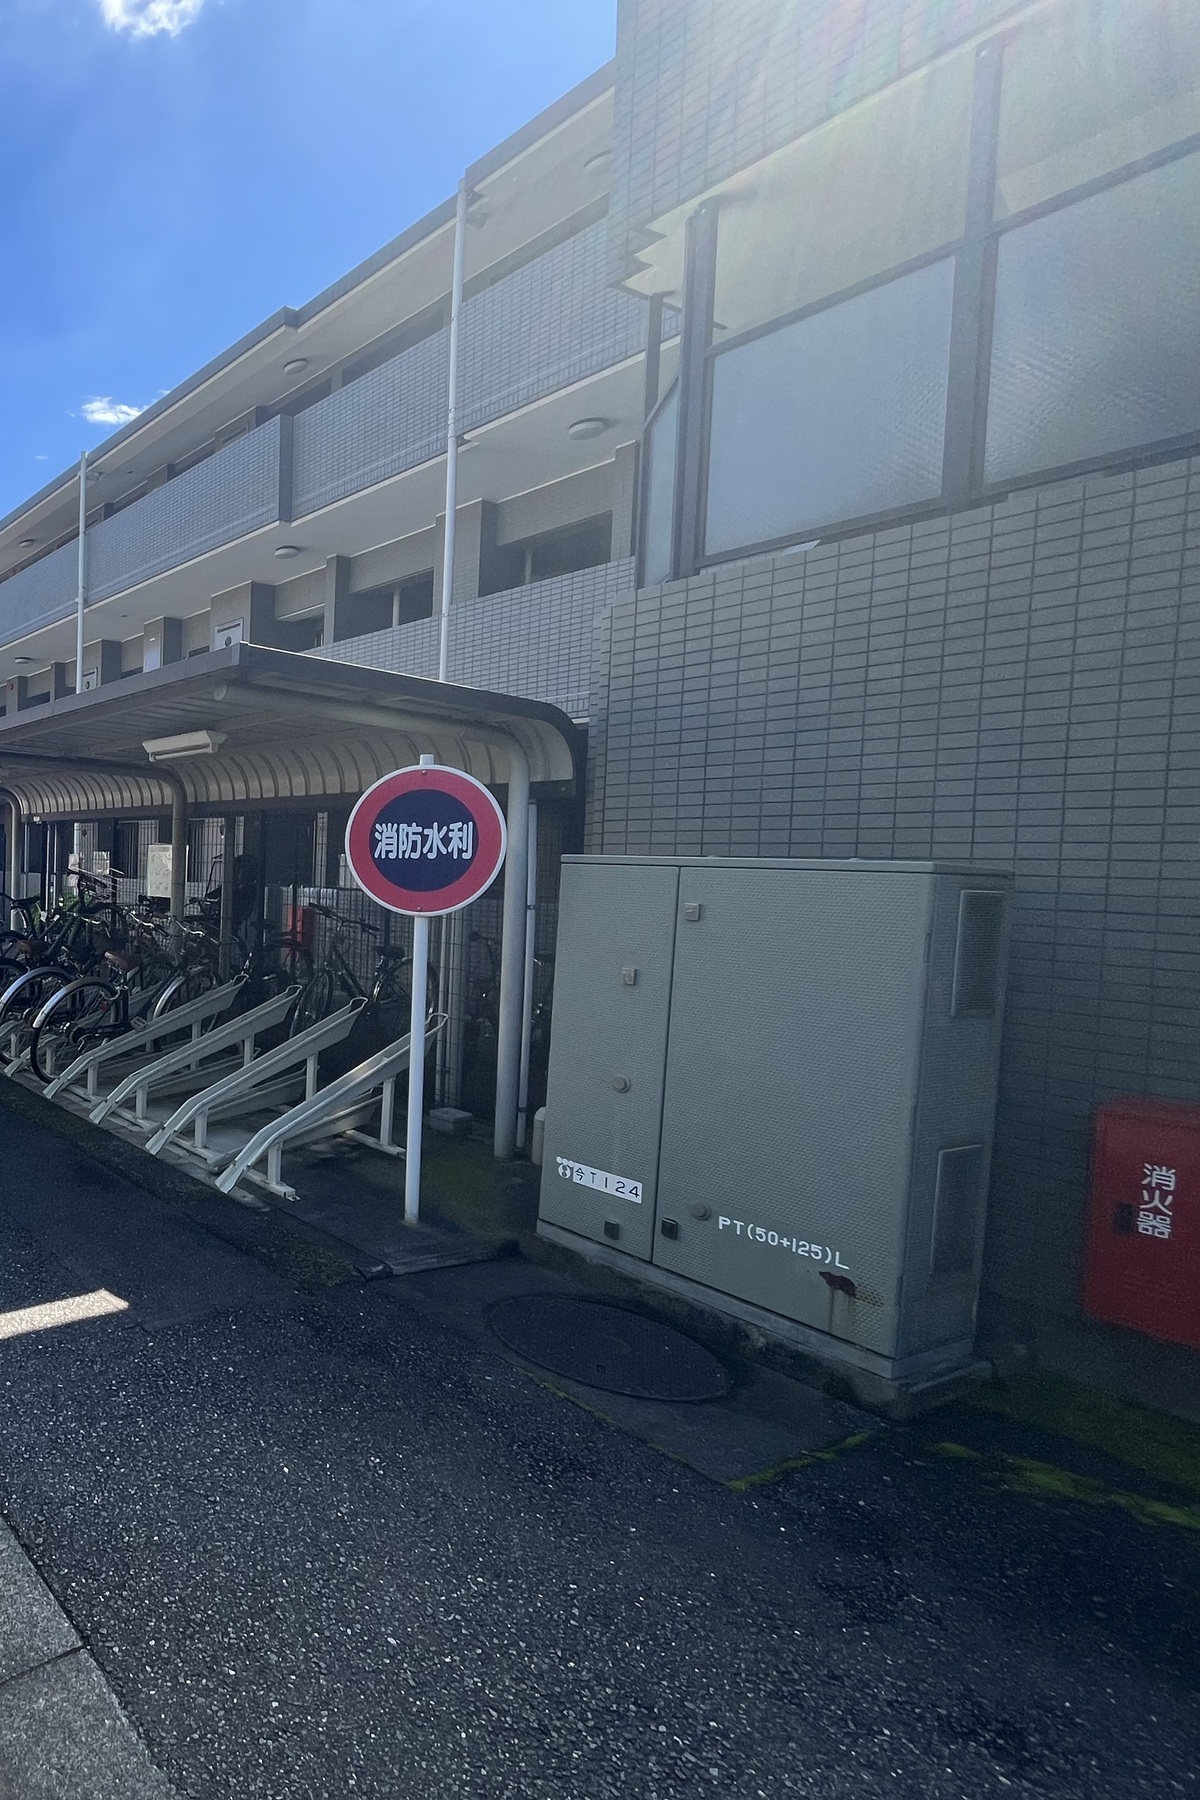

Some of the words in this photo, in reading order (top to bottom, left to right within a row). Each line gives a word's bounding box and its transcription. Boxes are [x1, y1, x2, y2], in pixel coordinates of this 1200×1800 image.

[374, 821, 473, 860] 消防水利
[1136, 1162, 1176, 1239] 消火器
[718, 1215, 850, 1270] PT(50+125)L
